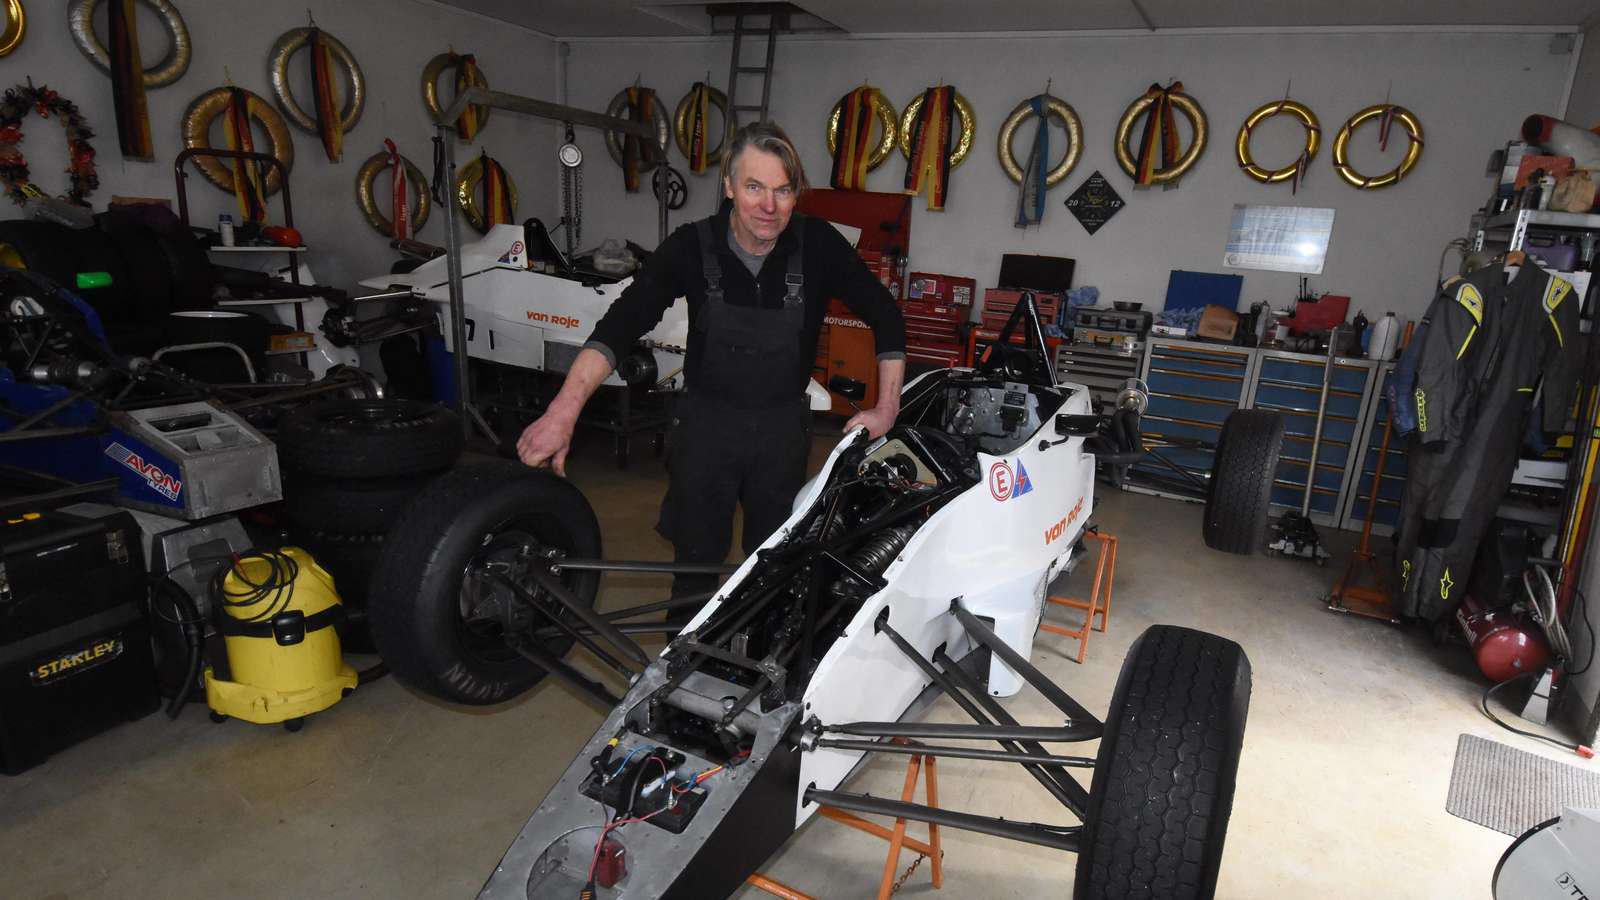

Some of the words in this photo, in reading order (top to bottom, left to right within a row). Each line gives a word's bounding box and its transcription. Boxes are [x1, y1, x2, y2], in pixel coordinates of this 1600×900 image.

[526, 311, 549, 322] van
[126, 454, 181, 493] AVON
[996, 470, 1008, 494] E
[147, 478, 178, 501] TYRES
[1044, 517, 1066, 546] van
[38, 639, 116, 679] STANLEY
